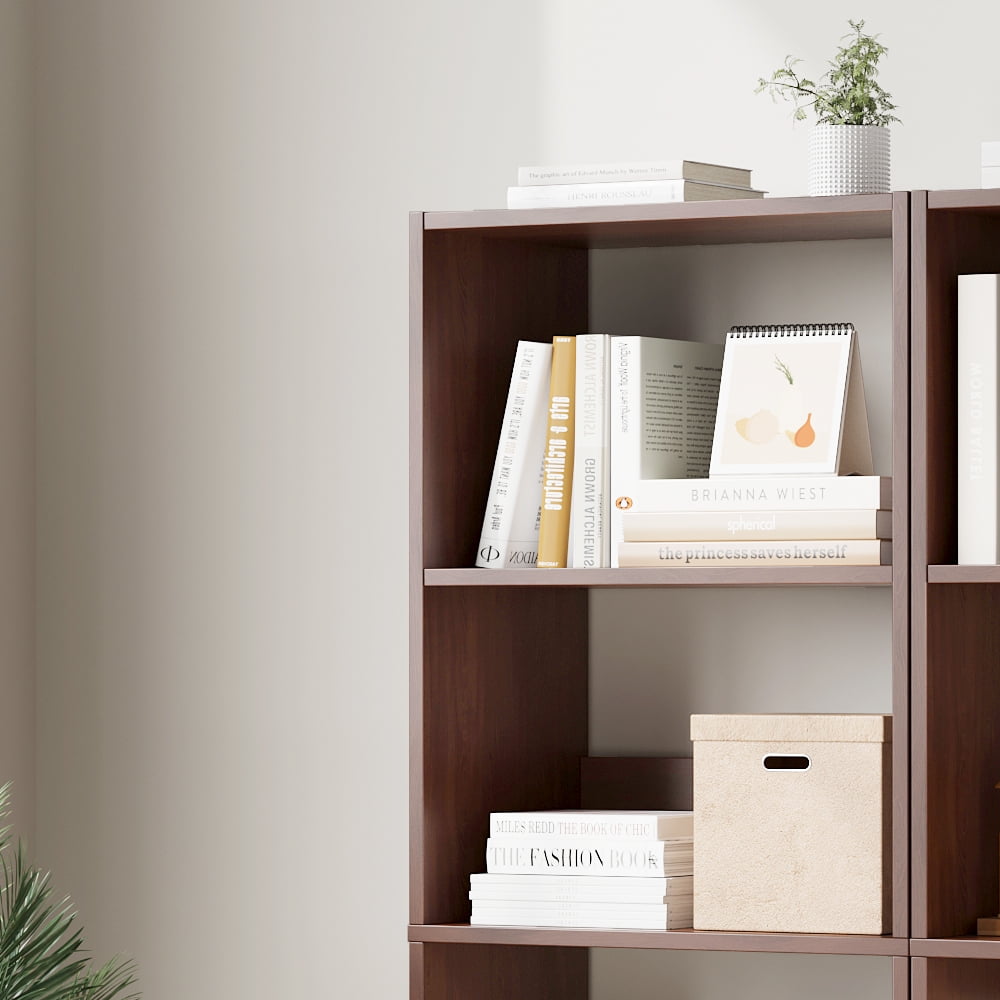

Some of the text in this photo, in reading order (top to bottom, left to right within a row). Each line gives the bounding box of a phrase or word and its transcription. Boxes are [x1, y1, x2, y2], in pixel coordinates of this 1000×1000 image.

[690, 487, 828, 503] BRIANNA WIEST
[658, 544, 848, 564] the princess saves herself
[496, 819, 650, 837] MILES REDD THE BOOK OF CHIC
[489, 847, 659, 869] THE FASHION BOOK
